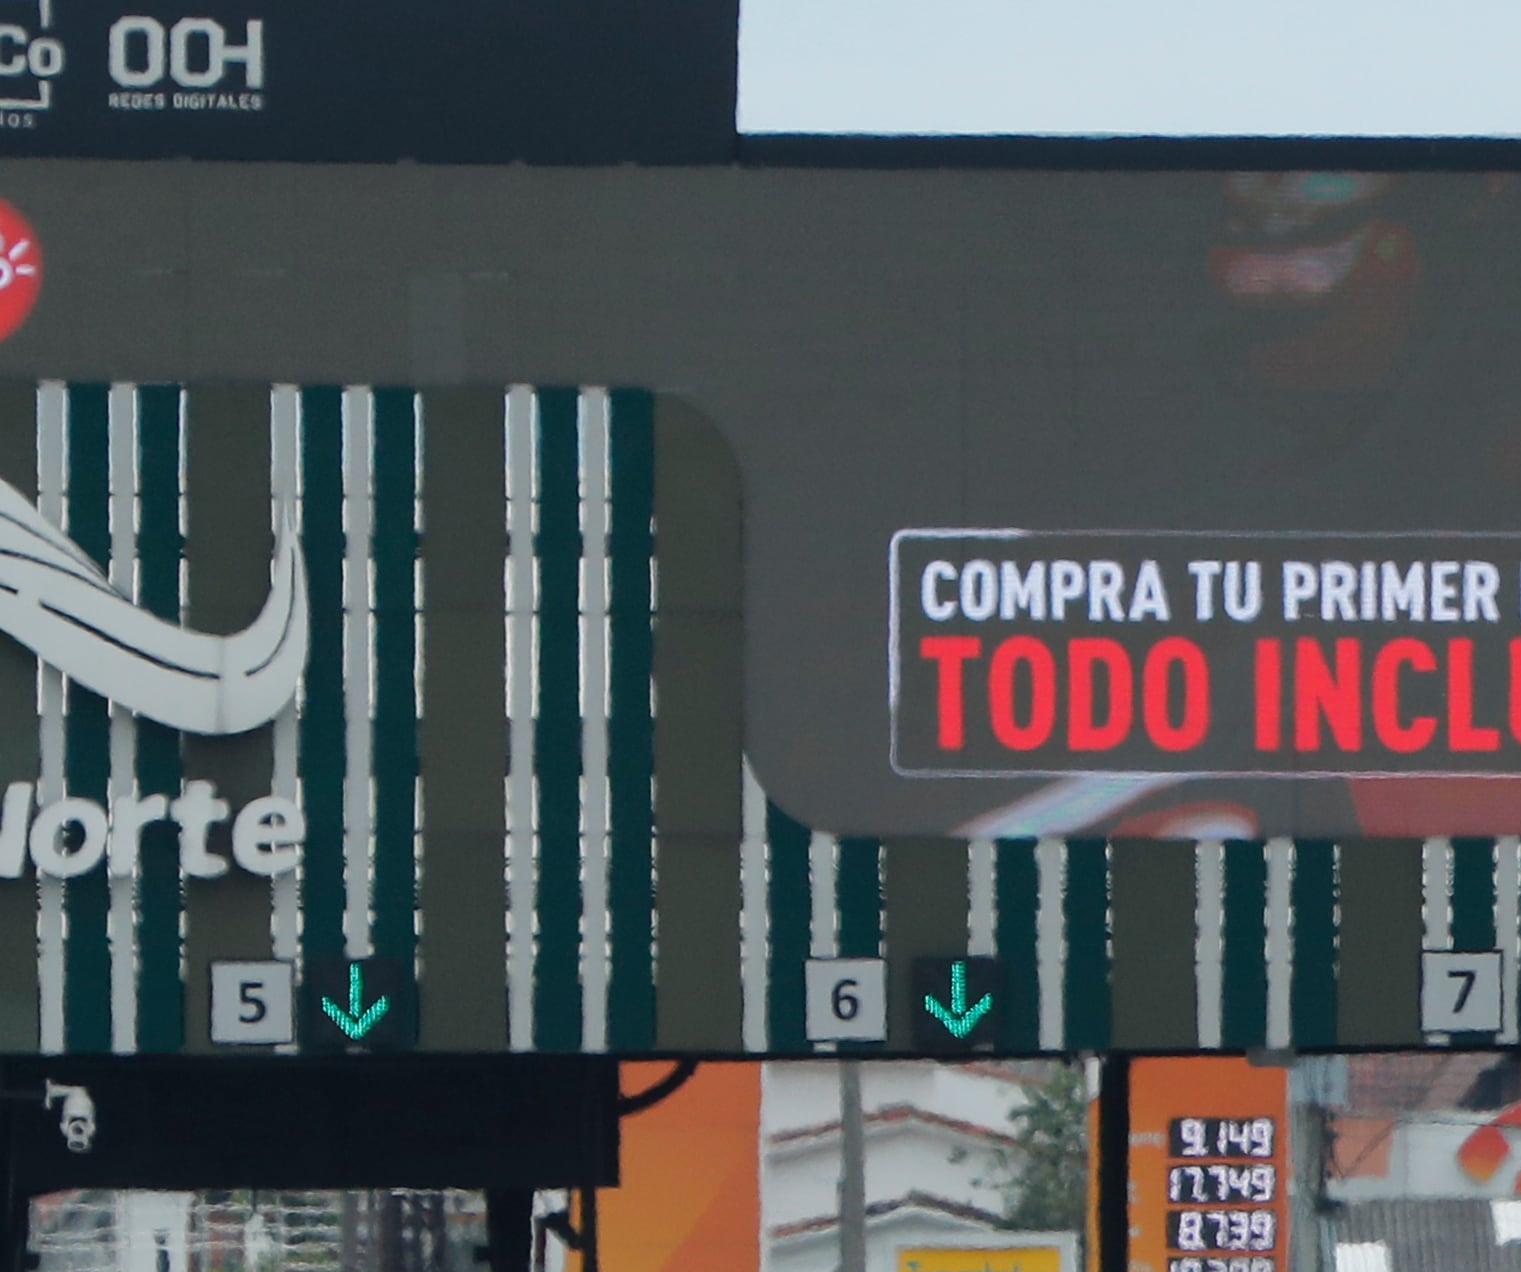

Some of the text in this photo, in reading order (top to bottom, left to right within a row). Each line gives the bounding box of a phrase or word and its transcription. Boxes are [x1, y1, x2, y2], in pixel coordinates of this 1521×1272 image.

[108, 92, 263, 110] REDES DIGITALES
[920, 560, 1171, 622] COMPRA
[1187, 561, 1263, 622] TU
[1283, 560, 1502, 623] PRIMER
[920, 635, 1210, 753] TODO
[238, 981, 267, 1025] 5
[831, 978, 859, 1021] 6
[1446, 970, 1478, 1014] 7
